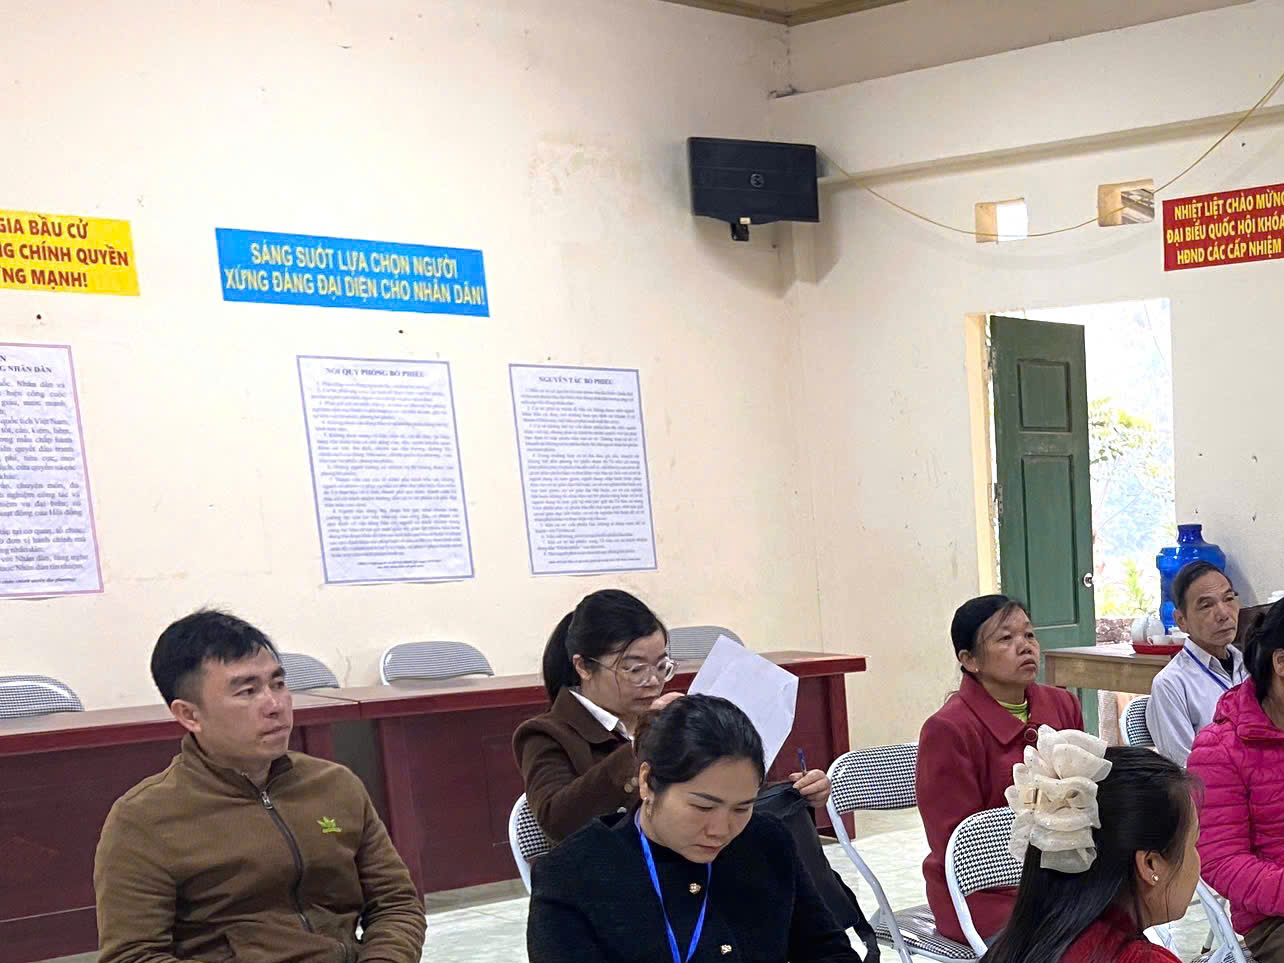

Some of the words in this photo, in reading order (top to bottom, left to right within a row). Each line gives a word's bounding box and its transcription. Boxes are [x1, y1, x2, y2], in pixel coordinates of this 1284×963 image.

[1174, 200, 1202, 221] NHIỆT
[1205, 196, 1224, 219] LIỆT
[1226, 192, 1253, 213] CHÀO
[28, 214, 62, 237] BẦU
[67, 218, 88, 239] CỬ
[1167, 228, 1183, 246] ĐẠI
[1185, 219, 1206, 241] BIỂU
[1208, 217, 1235, 239] QUỐC
[1238, 215, 1255, 237] HỘI
[19, 241, 71, 262] CHÍNH
[76, 244, 129, 266] QUYỀN
[251, 240, 293, 266] SÁNG
[337, 250, 368, 276] LỰA
[370, 252, 409, 279] CHỌN
[413, 254, 458, 279] NGƯỜI
[1177, 247, 1205, 264] HĐND
[1207, 241, 1225, 261] CÁC
[1227, 238, 1246, 259] CẤP
[1249, 234, 1281, 258] NHIỆM
[31, 269, 88, 290] MẠNH!
[225, 264, 269, 291] XỨNG
[272, 267, 314, 294] ĐÁNG
[317, 274, 342, 300] ĐẠI
[344, 275, 377, 302] DIỆN
[381, 279, 410, 300] CHO
[413, 279, 451, 303] NHÂN
[454, 281, 486, 305] DÂN!
